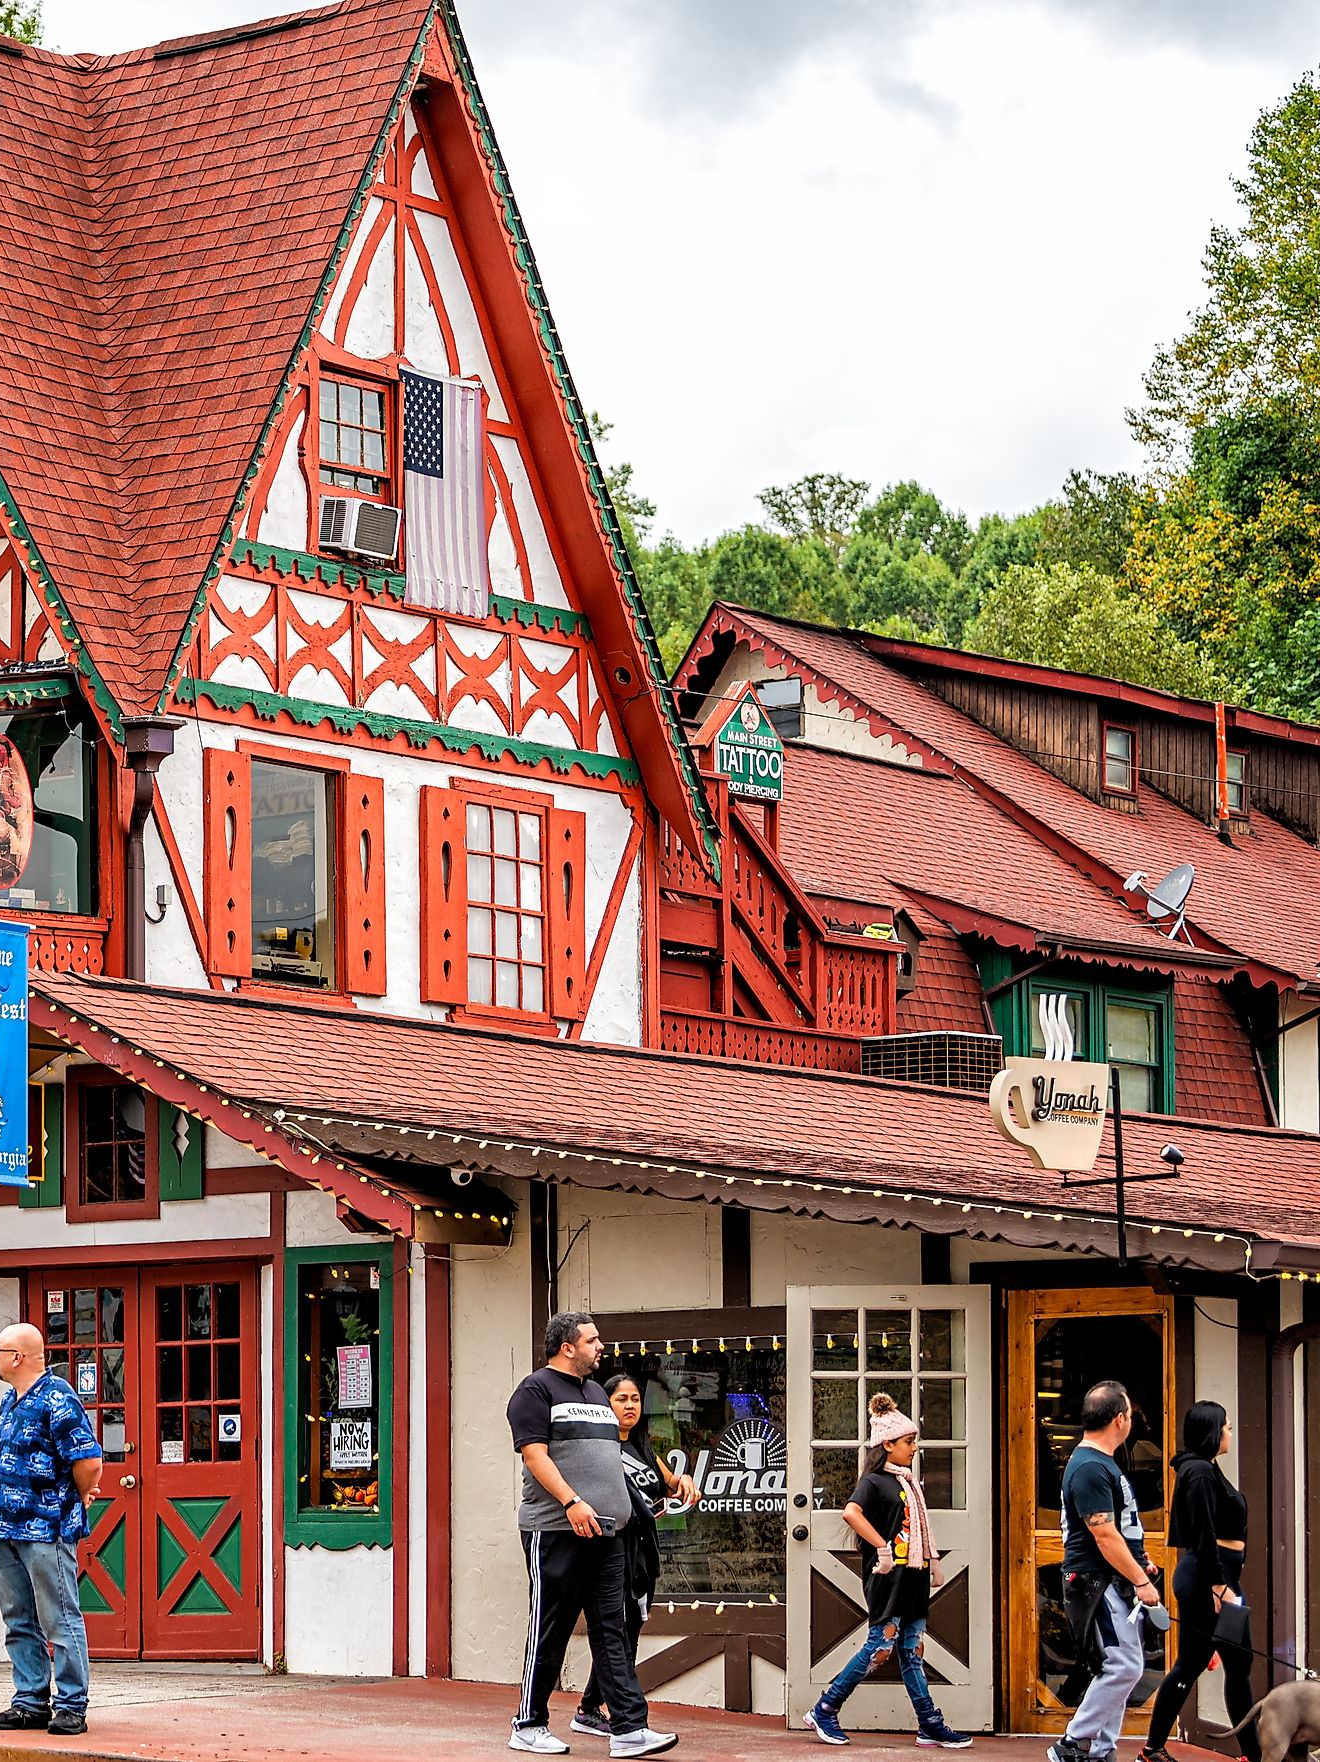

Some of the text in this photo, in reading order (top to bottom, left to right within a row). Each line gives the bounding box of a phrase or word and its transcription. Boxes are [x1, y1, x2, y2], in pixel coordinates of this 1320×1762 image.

[727, 730, 777, 748] MAIN STREET
[720, 742, 781, 779] TATTOO
[727, 781, 779, 798] ODY PIERCING
[1031, 1075, 1104, 1120] Yonah
[1070, 1115, 1099, 1126] COMPANY
[567, 1407, 600, 1417] KENNETH
[340, 1423, 364, 1436] NOW
[333, 1432, 370, 1451] HIRING
[698, 1498, 824, 1512] COFFEE COMY
